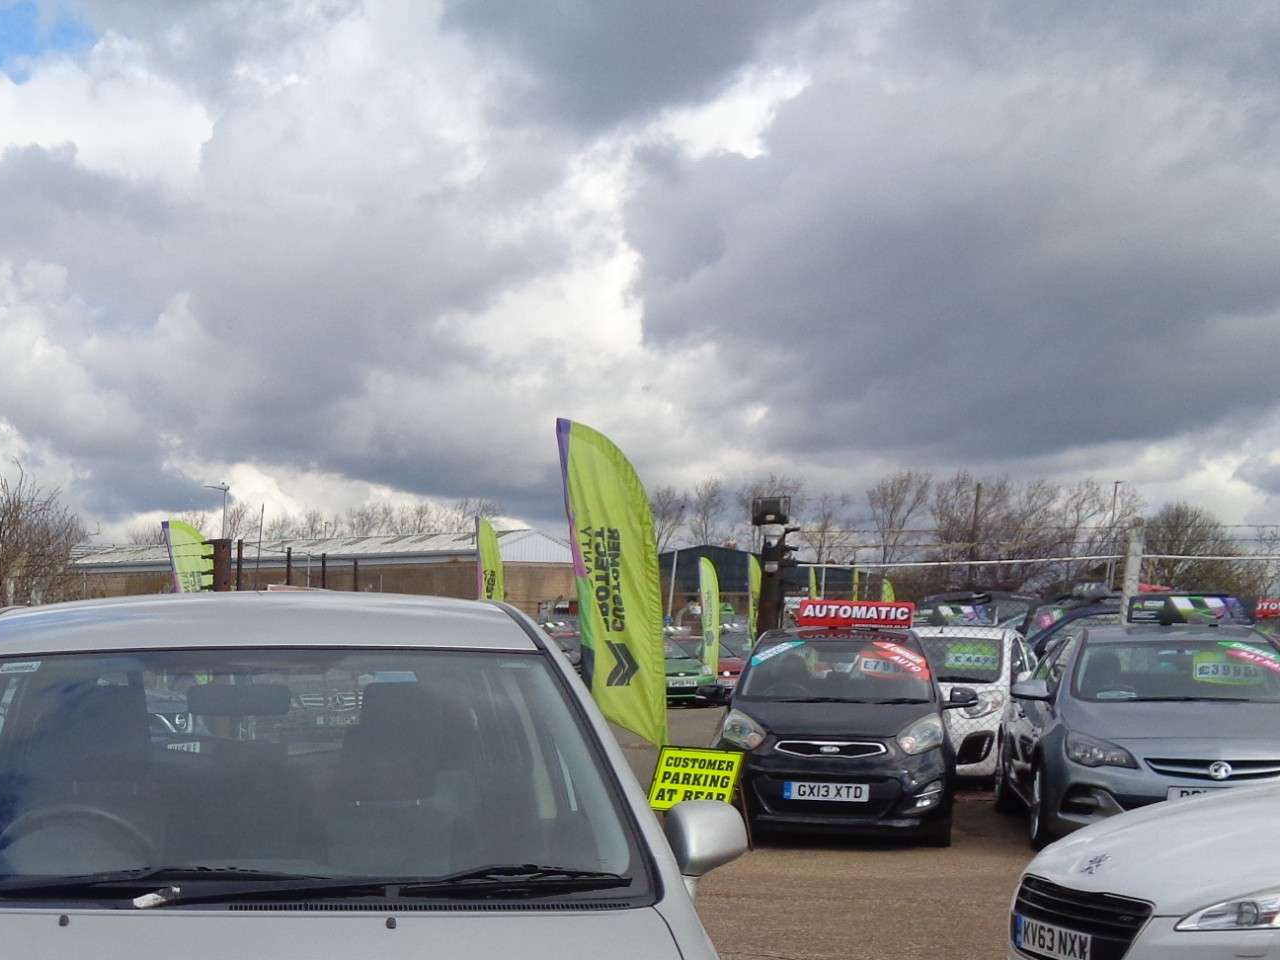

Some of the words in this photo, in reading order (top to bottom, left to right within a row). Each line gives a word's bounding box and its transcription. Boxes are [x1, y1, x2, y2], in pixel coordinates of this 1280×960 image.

[803, 604, 910, 620] AUTOMATIC
[665, 756, 735, 771] CUSTOMER
[661, 771, 731, 788] PARKING
[655, 788, 677, 801] AT
[798, 784, 830, 798] GX13
[834, 785, 863, 799] XTD
[1024, 920, 1055, 952] KV63
